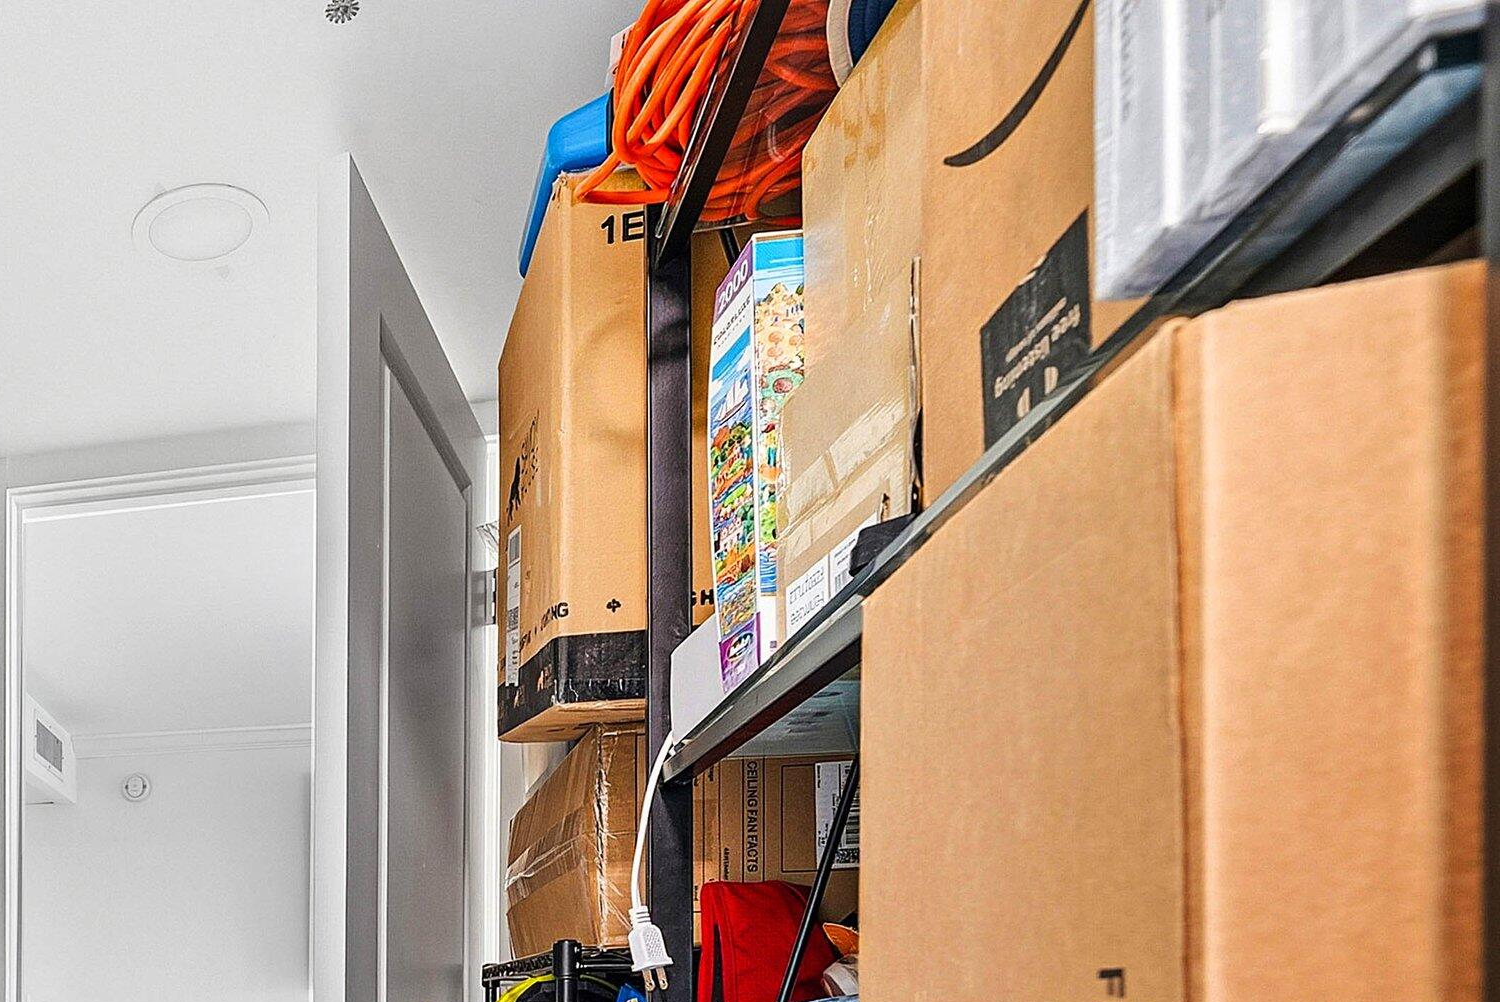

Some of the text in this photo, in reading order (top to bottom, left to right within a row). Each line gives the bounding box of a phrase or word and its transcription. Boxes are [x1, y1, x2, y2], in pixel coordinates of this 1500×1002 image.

[717, 259, 749, 315] 2000
[746, 760, 758, 873] CEILING FAN FACTS
